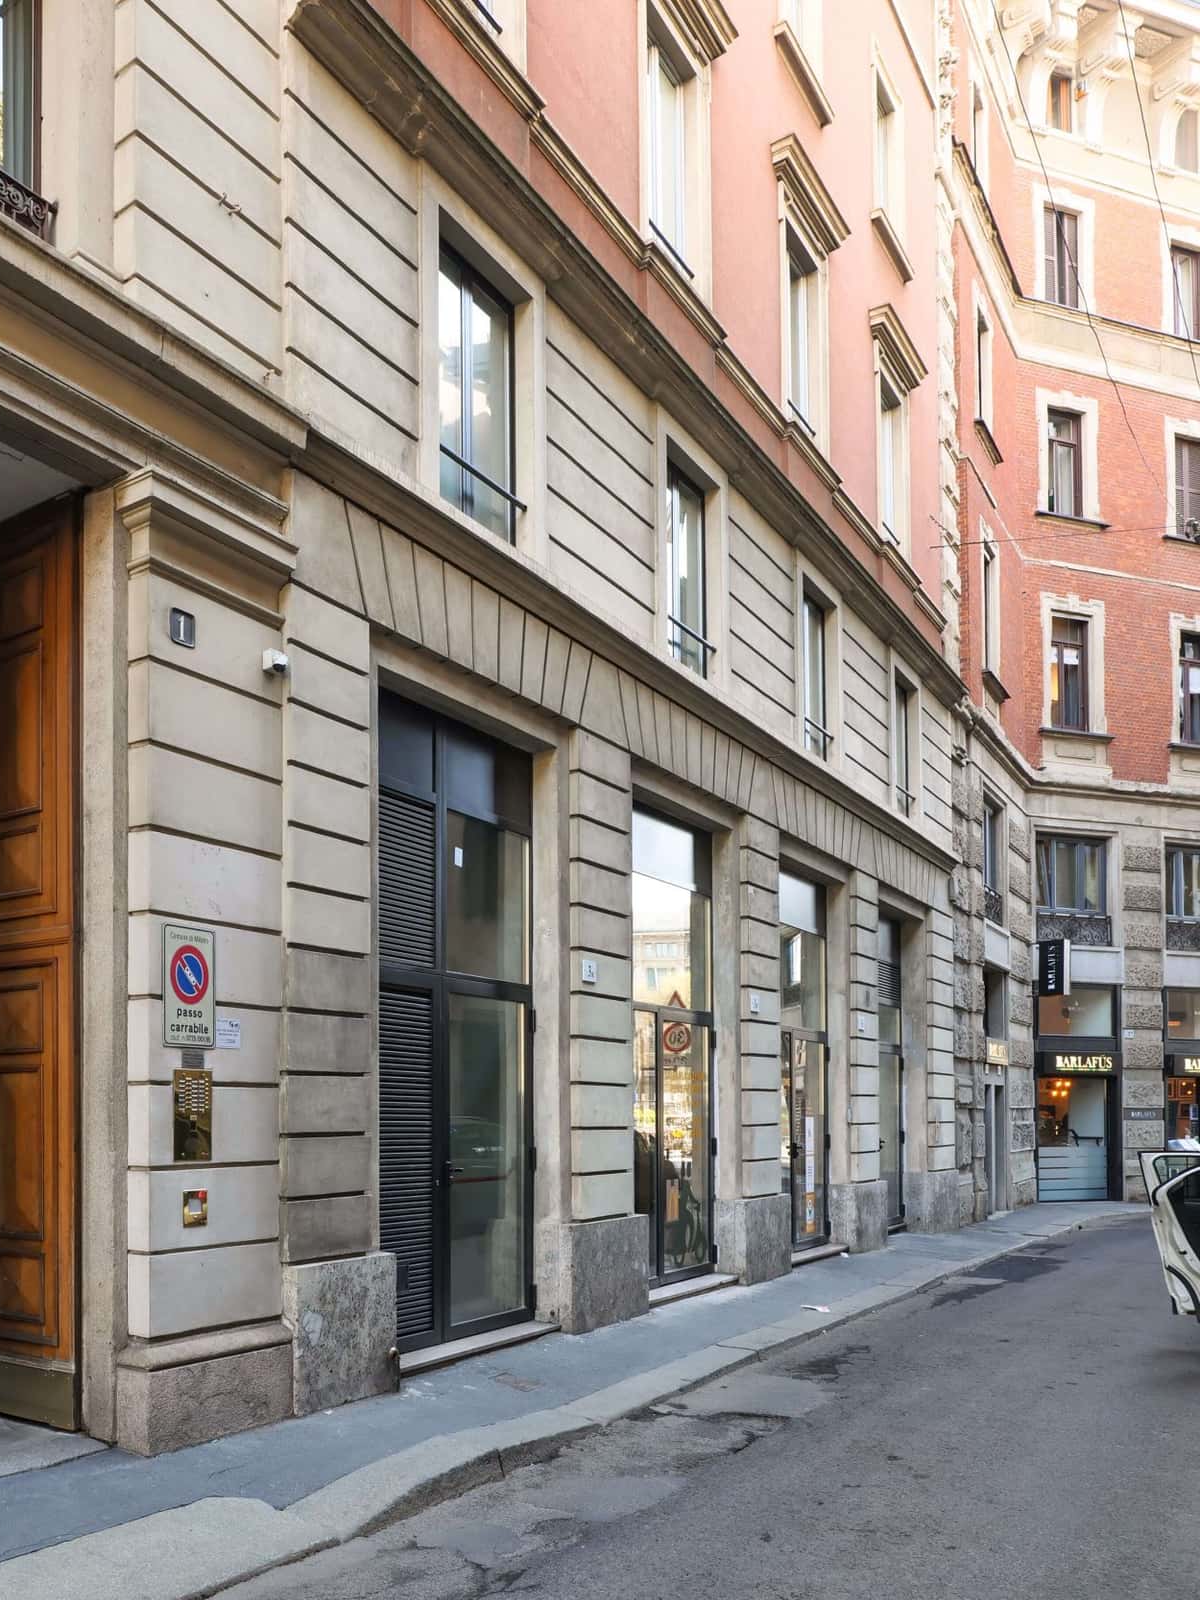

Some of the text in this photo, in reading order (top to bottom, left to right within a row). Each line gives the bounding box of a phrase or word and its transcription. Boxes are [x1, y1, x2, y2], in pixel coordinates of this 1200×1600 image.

[177, 615, 185, 641] 1
[177, 1007, 203, 1019] passo
[170, 1023, 209, 1034] carrabile
